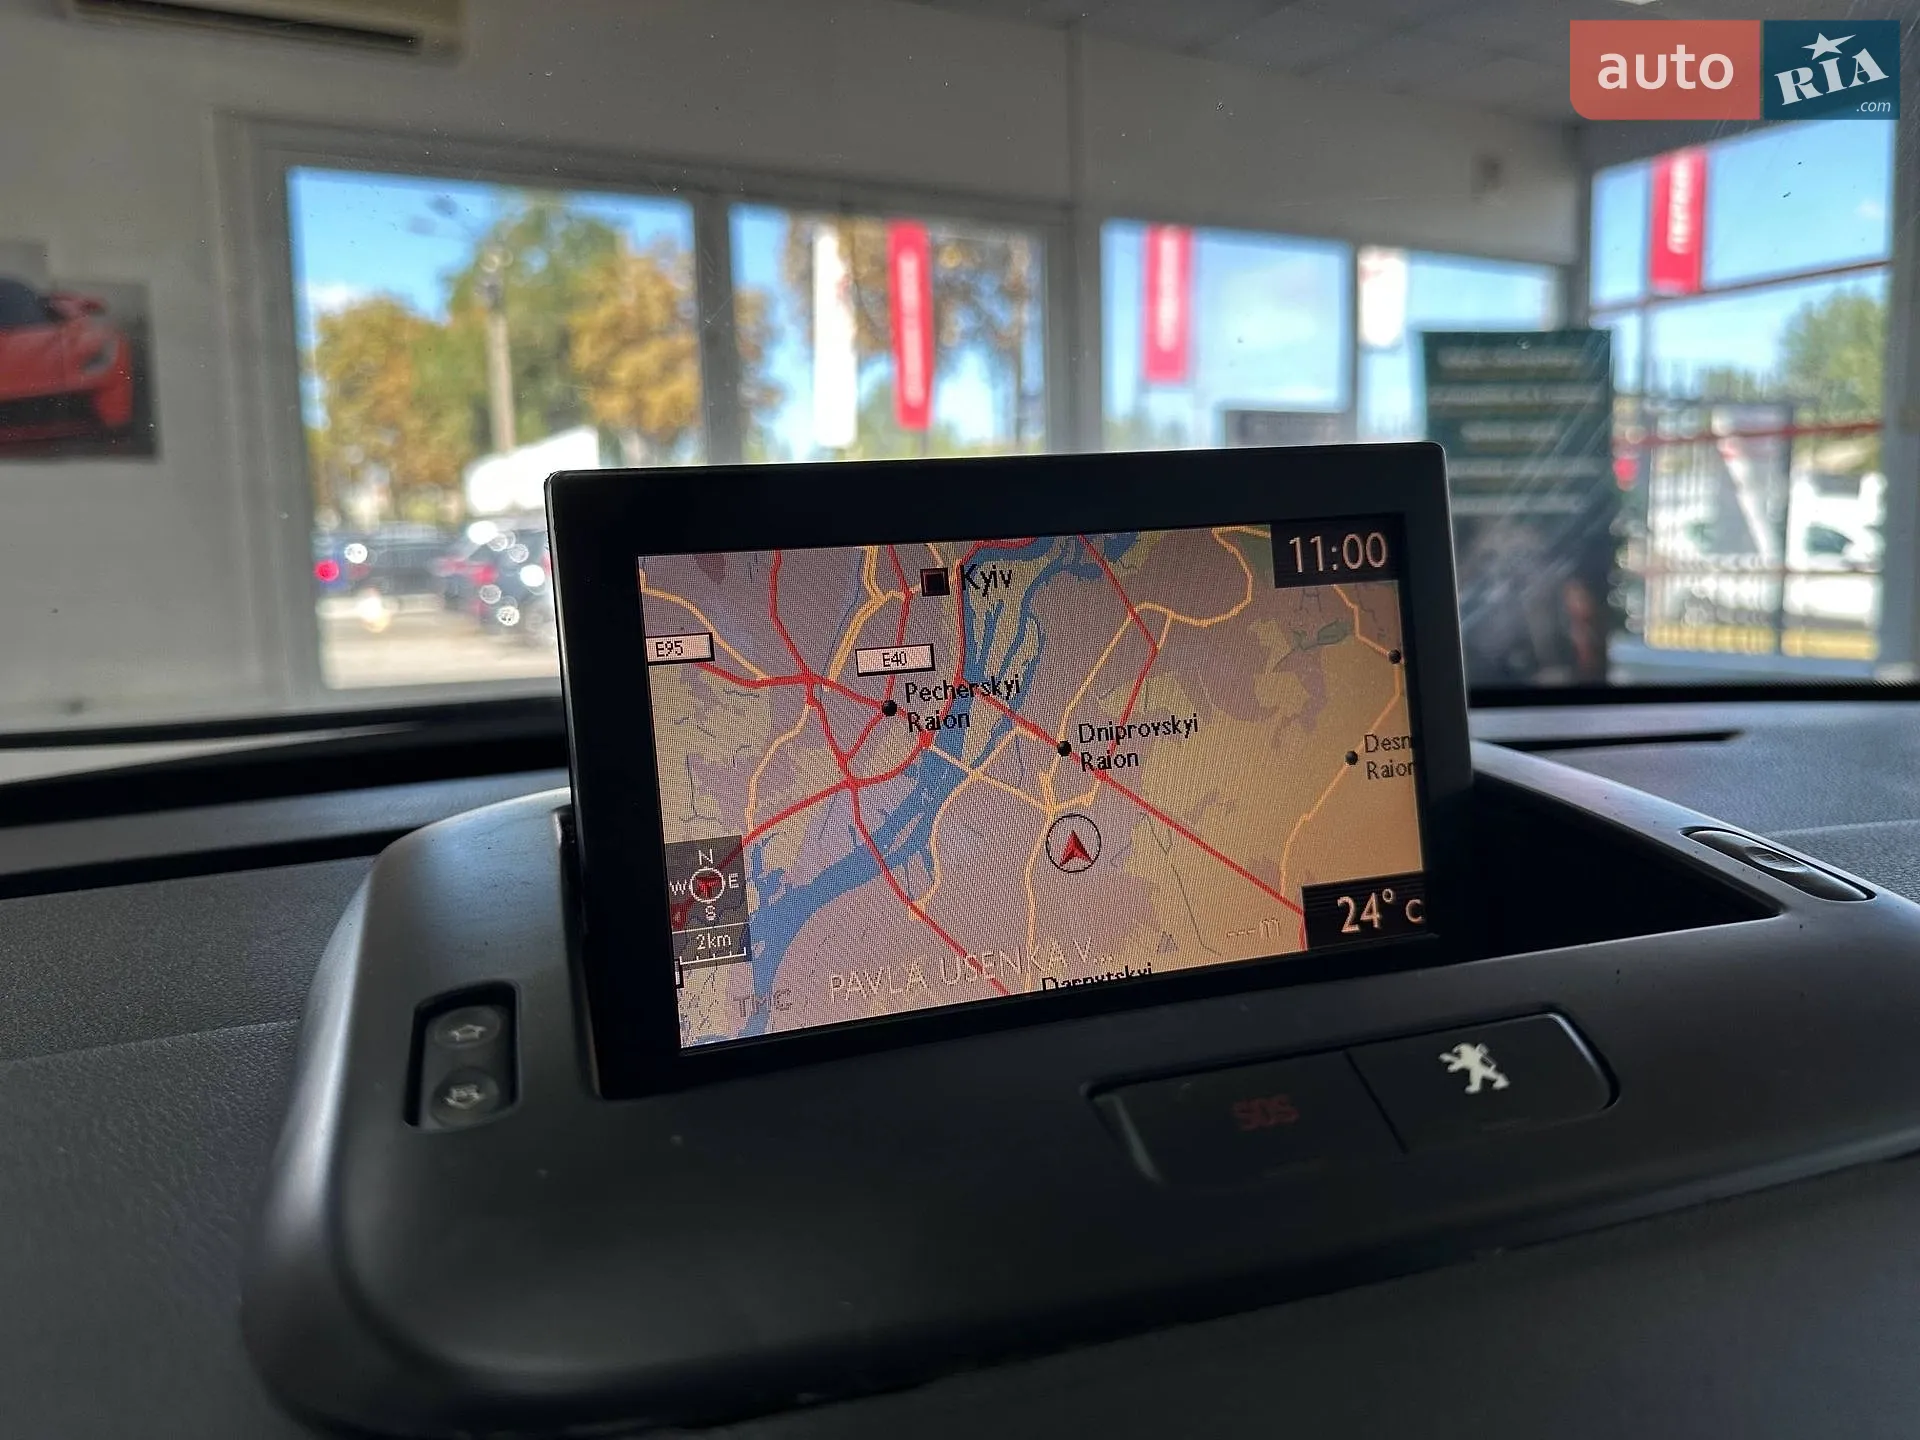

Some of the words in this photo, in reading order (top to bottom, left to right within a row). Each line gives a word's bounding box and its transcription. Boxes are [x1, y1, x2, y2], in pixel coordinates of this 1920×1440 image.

[1289, 532, 1387, 574] 11:00
[960, 564, 1013, 597] Kyiv
[655, 640, 684, 657] E95
[882, 651, 907, 668] E40
[905, 674, 1020, 703] Pecherskyi
[907, 710, 970, 732] Raion
[1078, 713, 1199, 744] Dniprovskyi
[1080, 752, 1139, 773] Raion
[698, 848, 714, 865] N
[669, 880, 688, 896] W
[728, 873, 740, 889] E
[1337, 888, 1393, 933] 24°
[696, 932, 732, 950] 2km
[830, 962, 928, 1004] PAVLA
[1232, 1093, 1299, 1132] SOS
